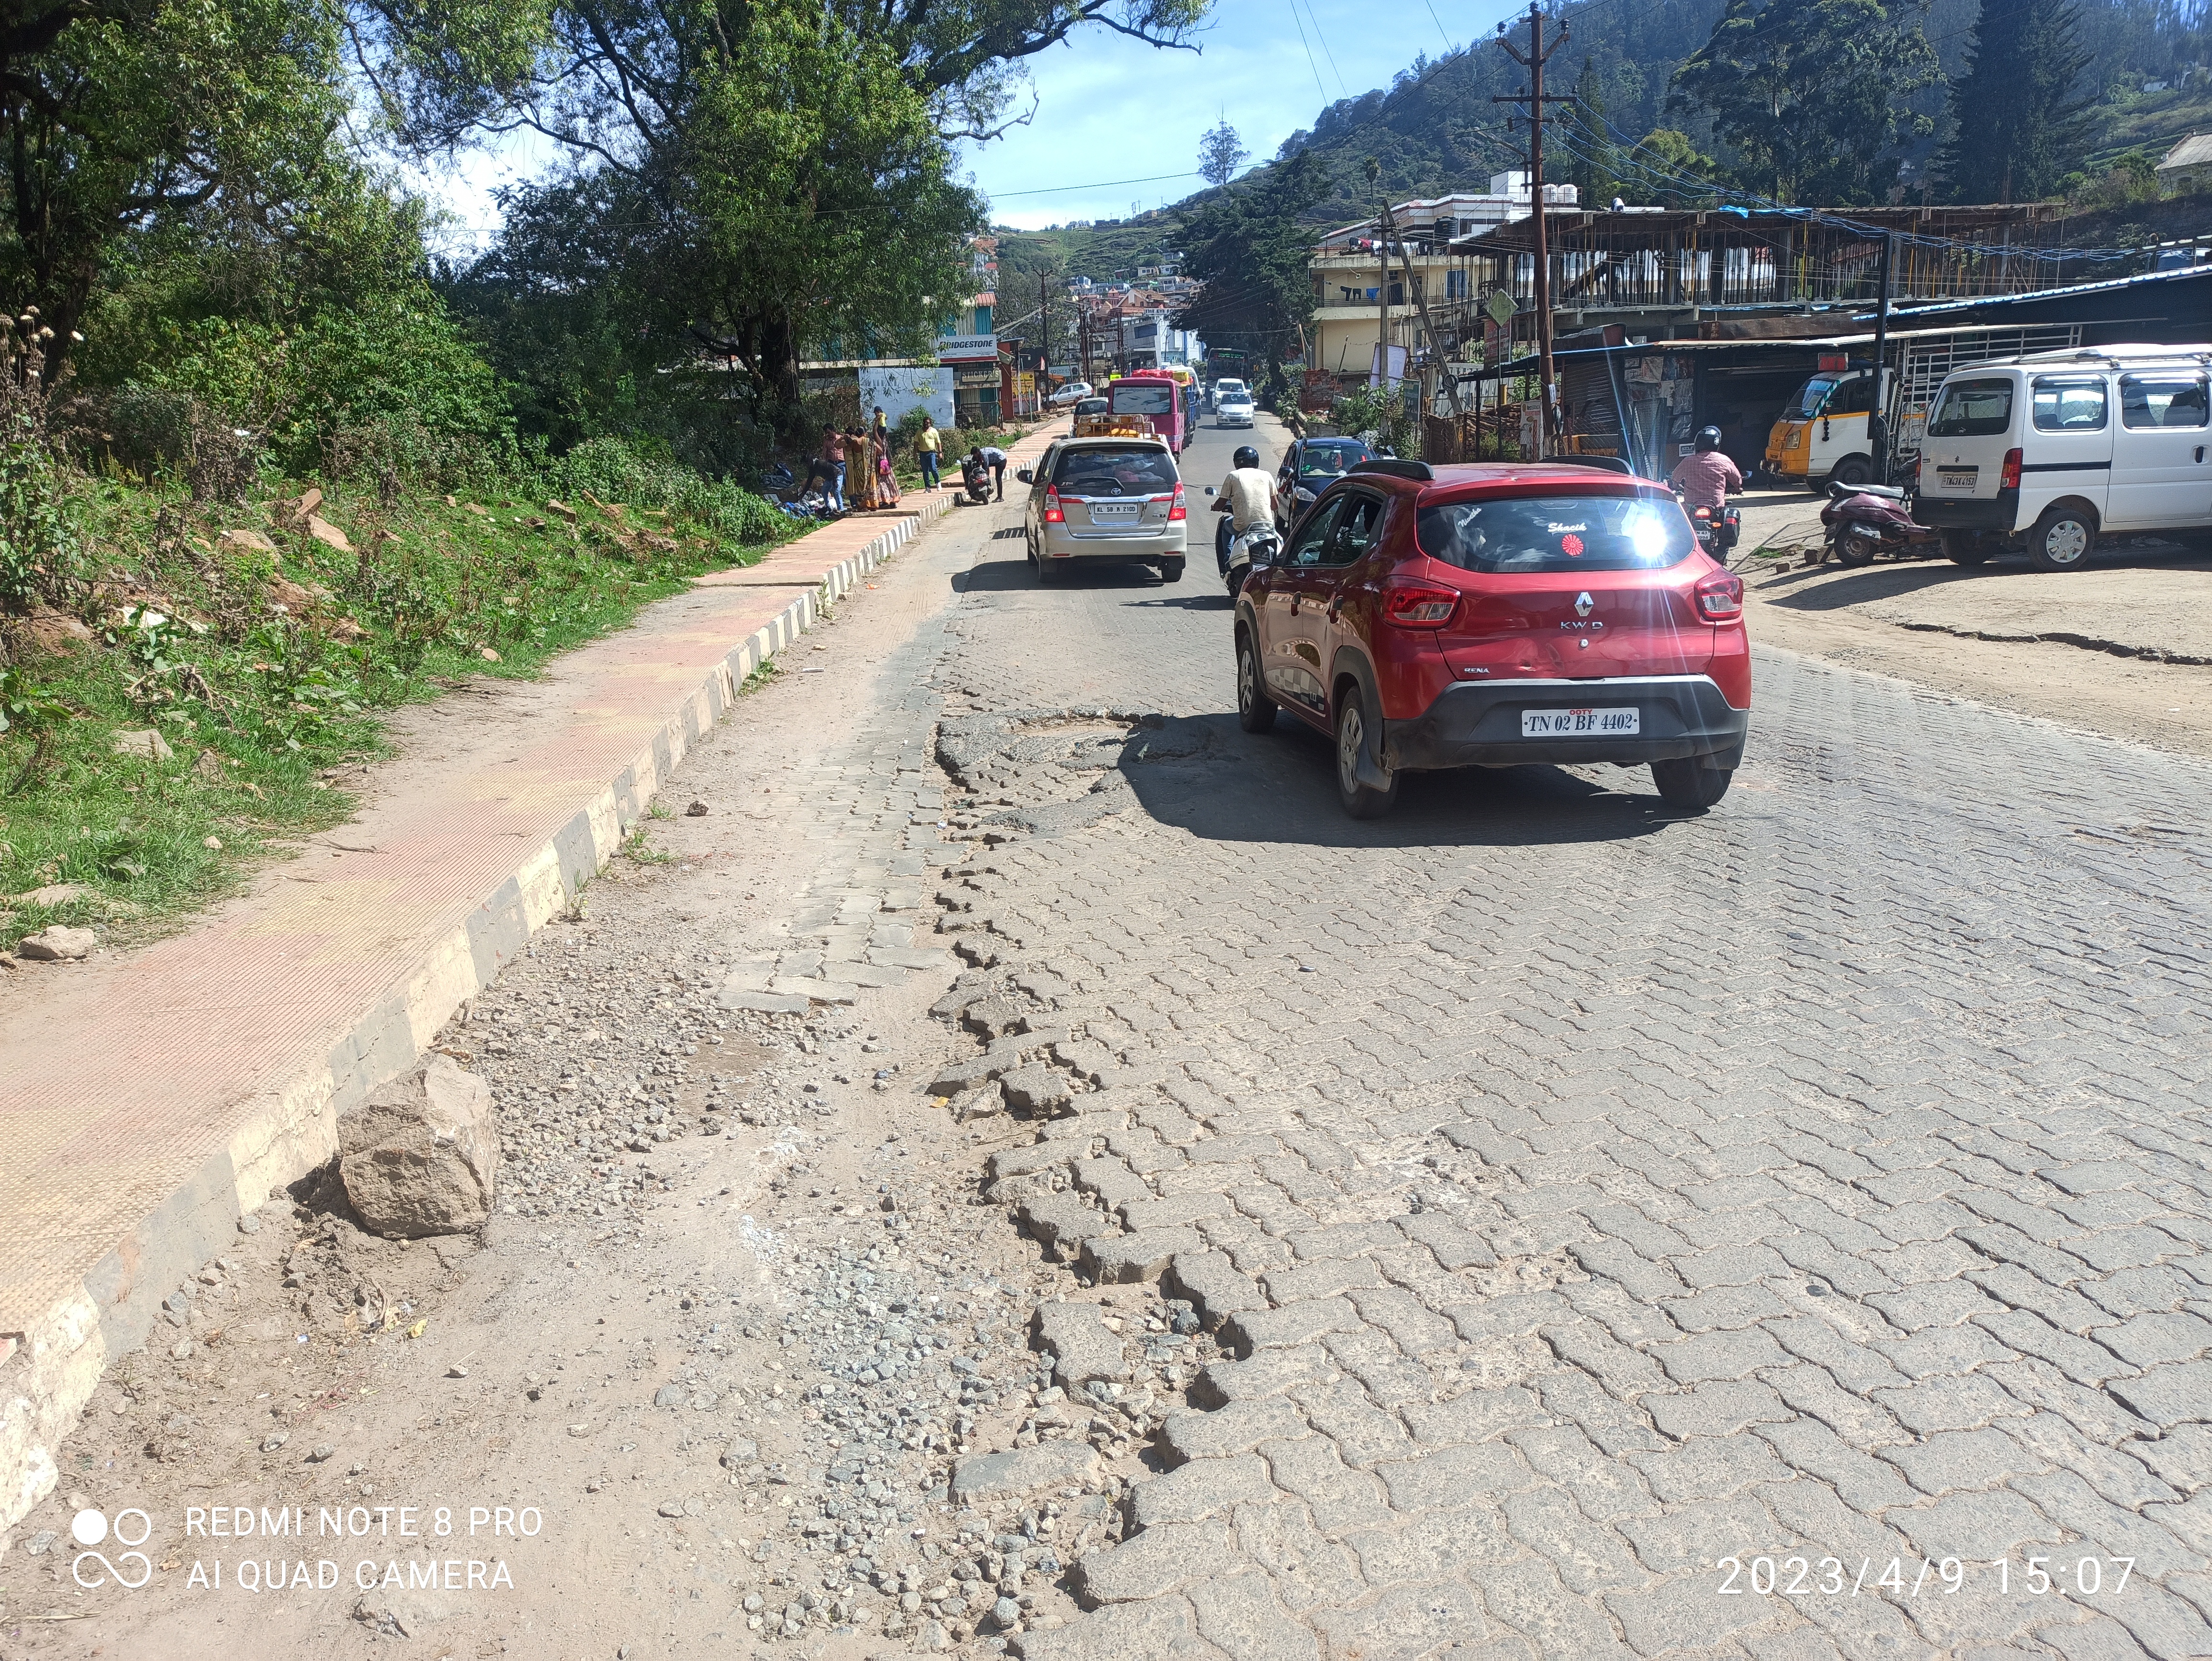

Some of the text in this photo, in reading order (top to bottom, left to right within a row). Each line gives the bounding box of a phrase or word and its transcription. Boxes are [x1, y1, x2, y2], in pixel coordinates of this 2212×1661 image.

[962, 370, 999, 378] STICKER'S
[1529, 713, 1633, 731] TN 02 BF 4402
